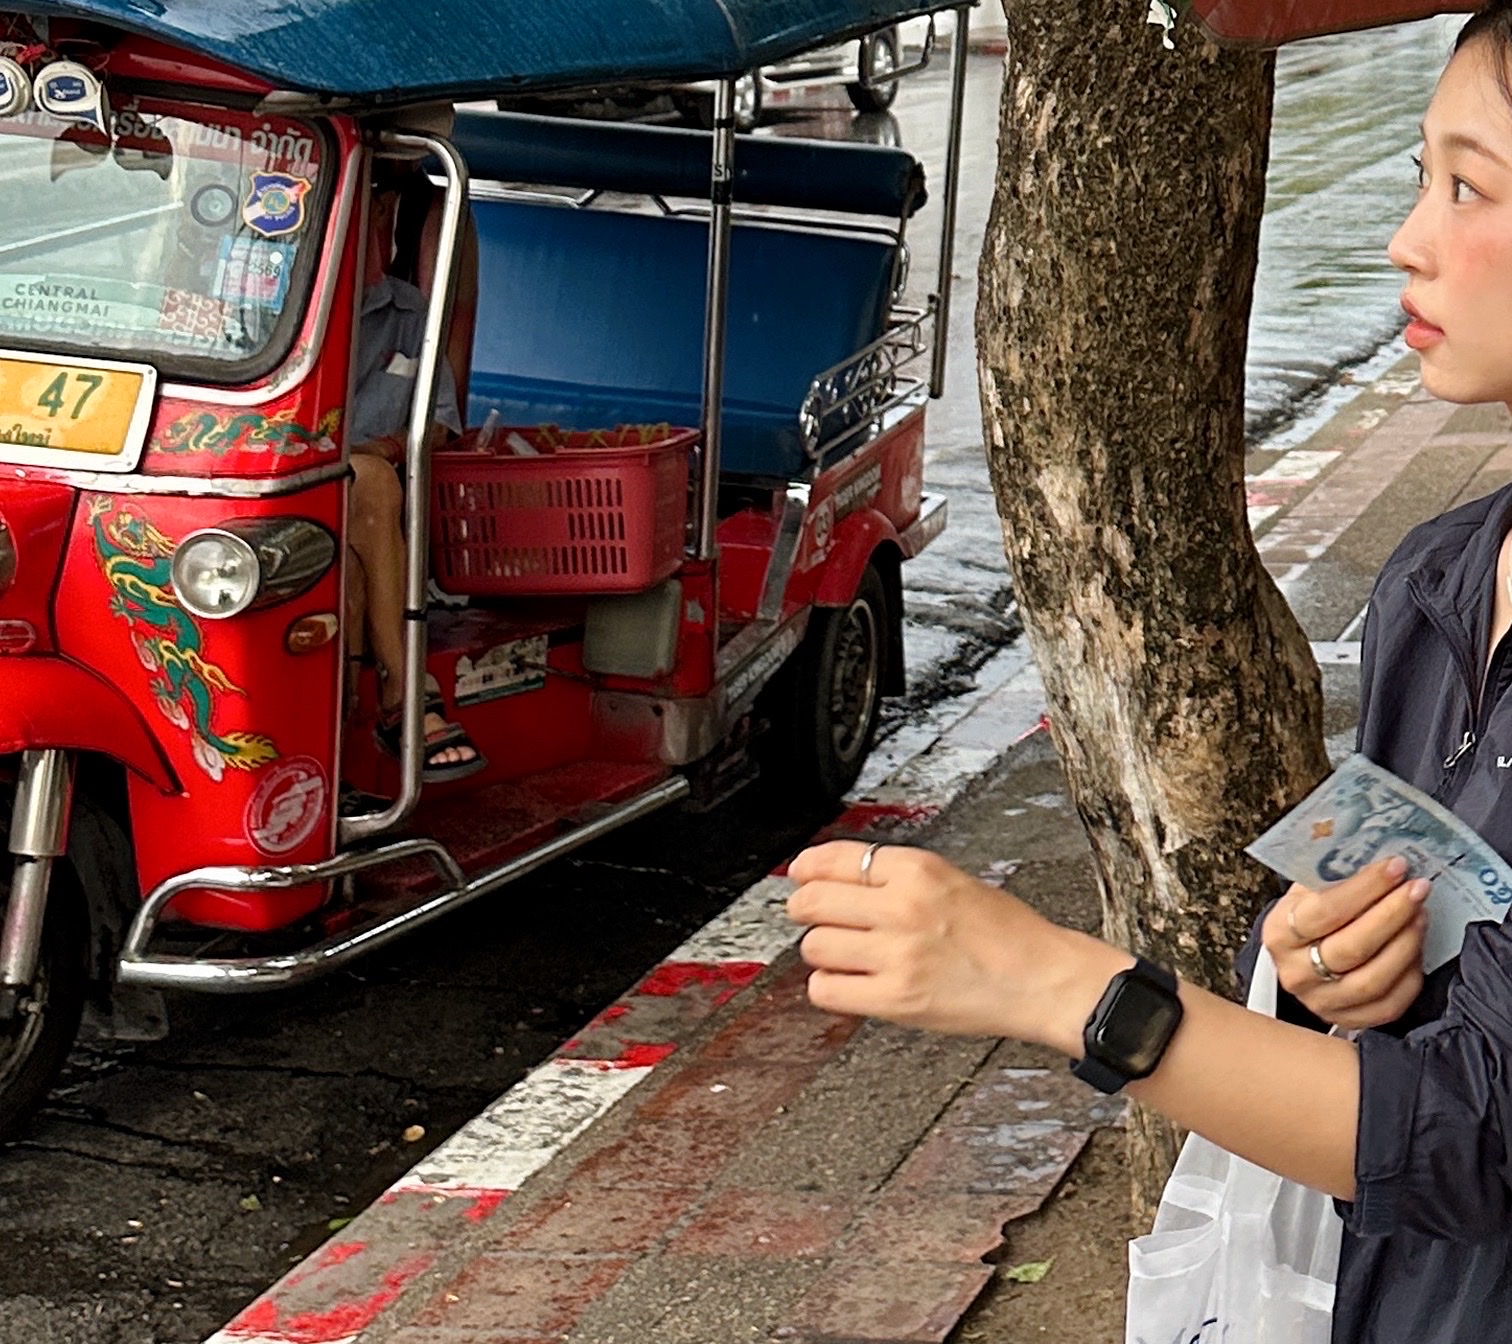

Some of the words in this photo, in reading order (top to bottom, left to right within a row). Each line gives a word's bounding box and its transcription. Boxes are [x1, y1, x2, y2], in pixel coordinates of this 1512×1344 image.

[15, 282, 99, 301] CENTRAL
[2, 296, 110, 317] CHIANGMAI
[37, 371, 103, 420] 47
